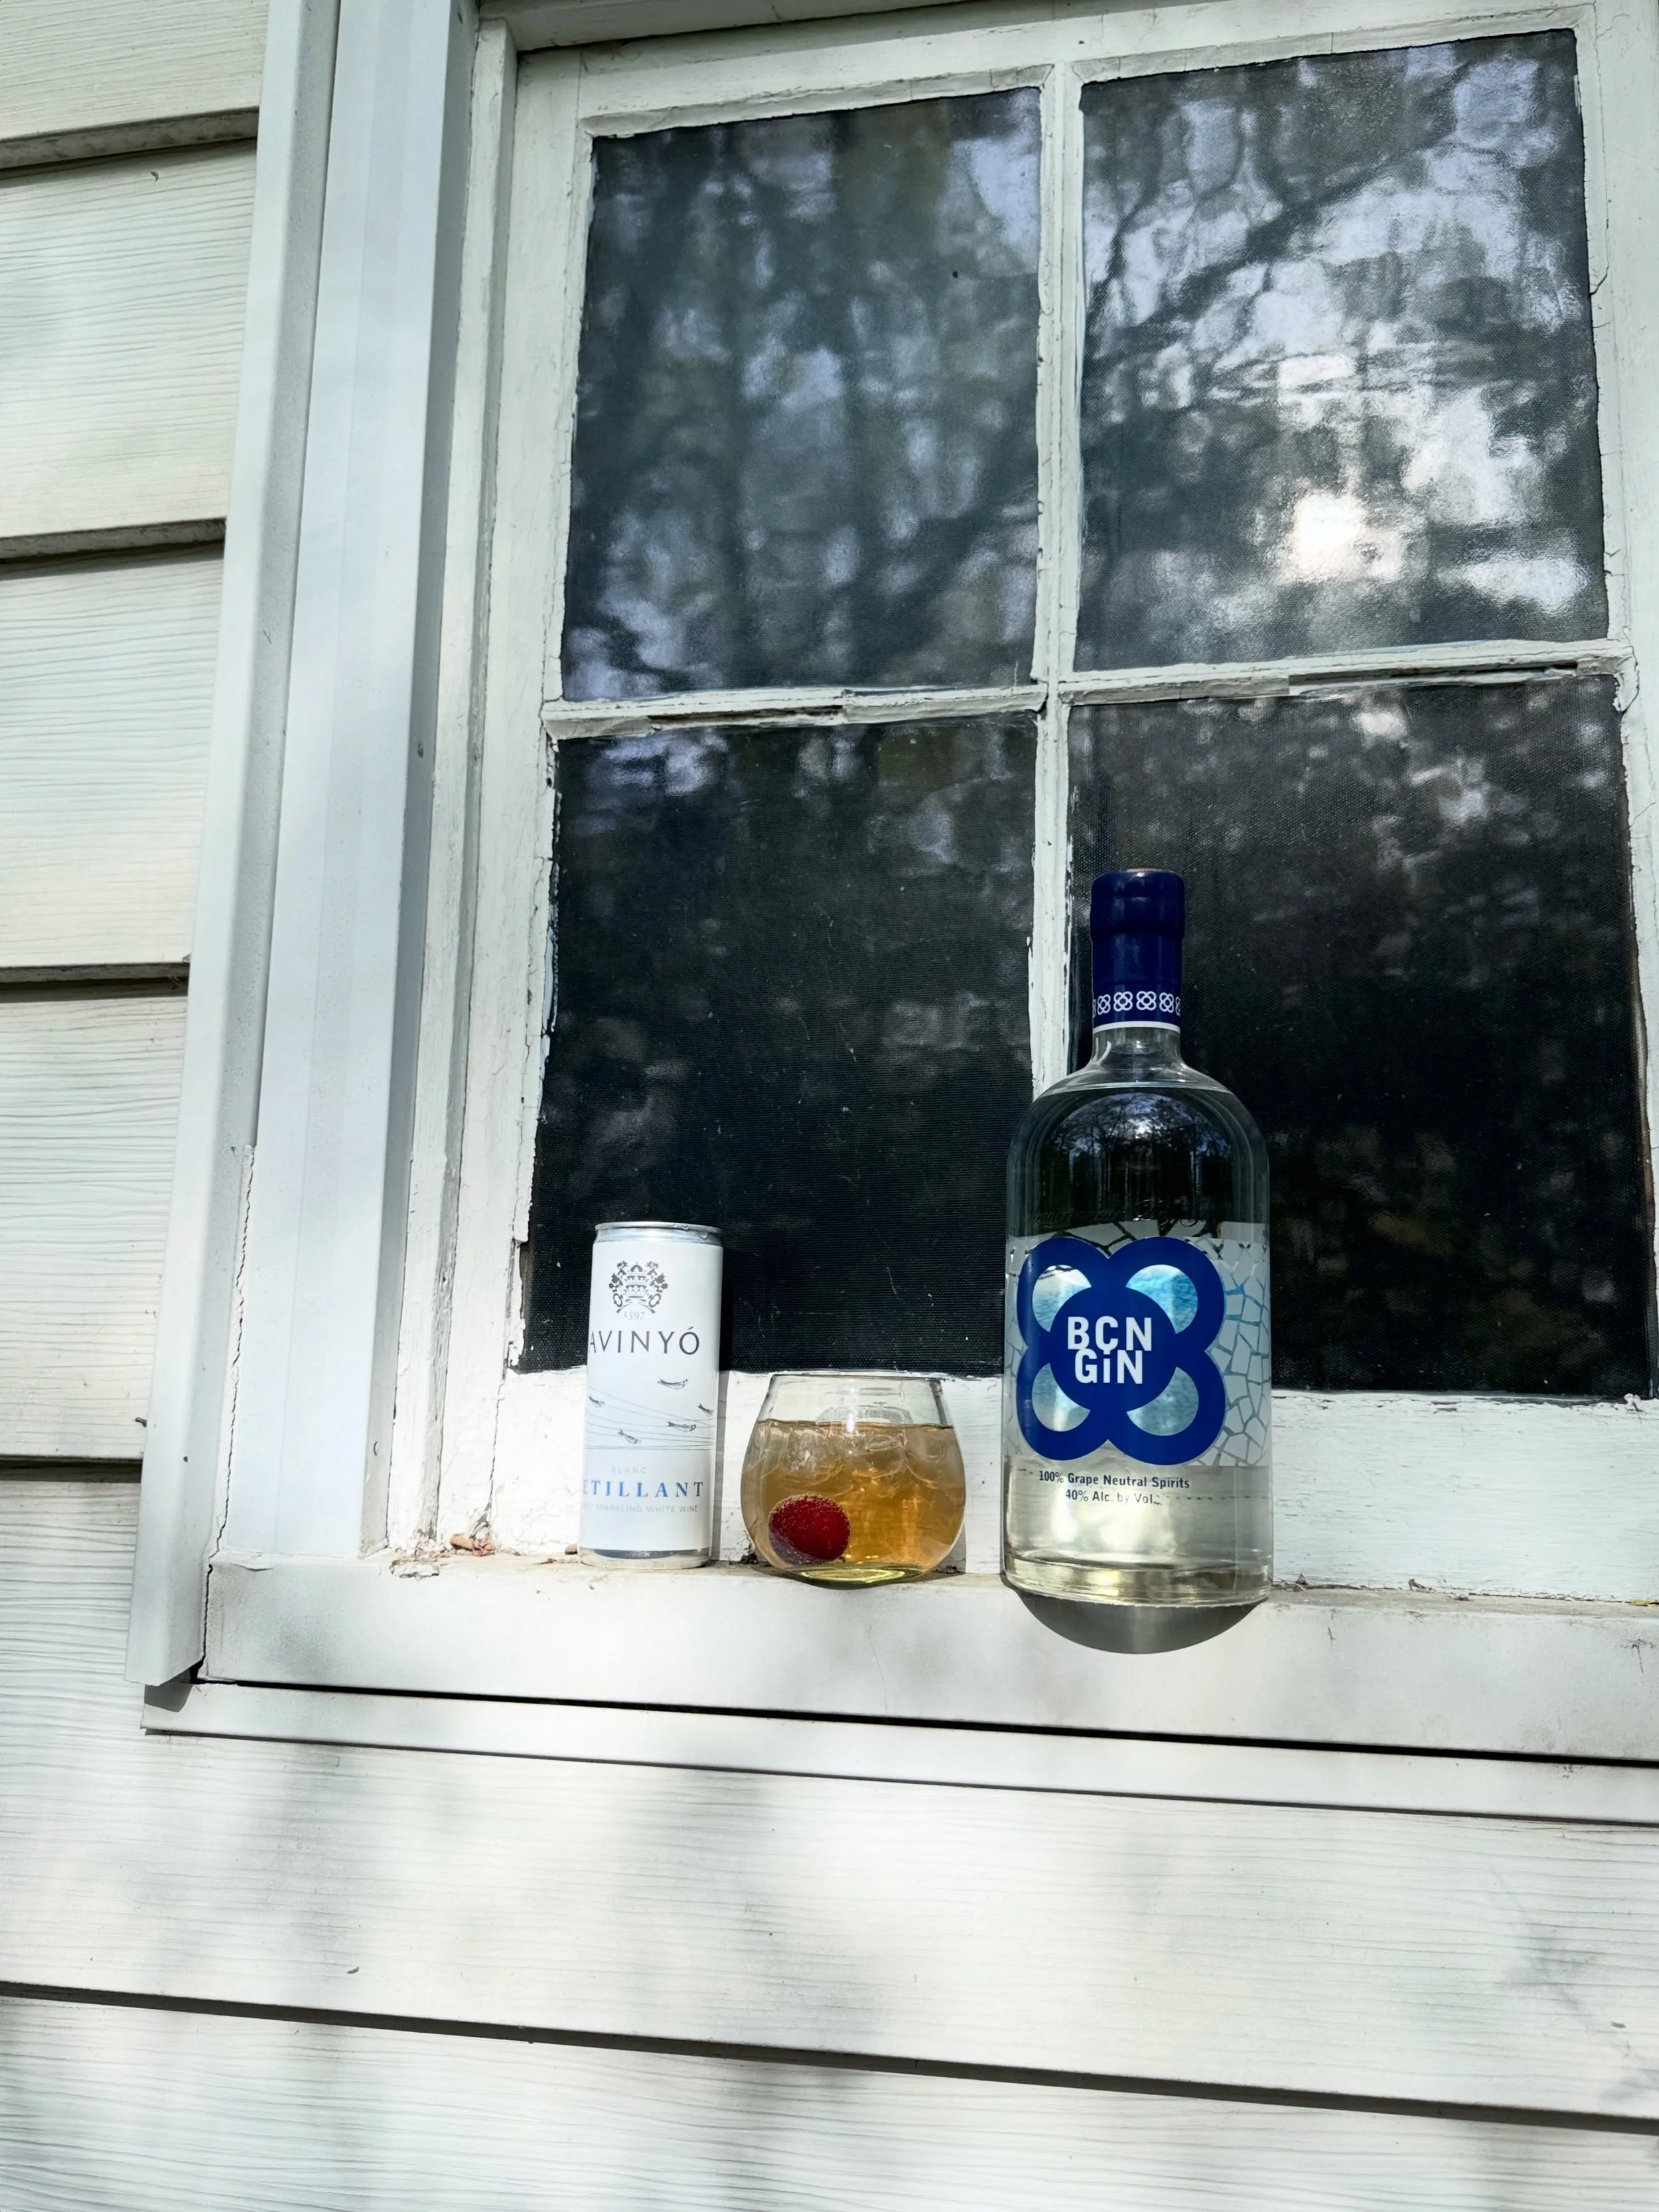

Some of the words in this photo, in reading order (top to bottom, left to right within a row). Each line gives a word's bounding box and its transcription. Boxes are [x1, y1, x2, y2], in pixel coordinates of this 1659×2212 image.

[624, 1311, 645, 1321] 1597
[1039, 1470, 1064, 1483] 100%
[1068, 1472, 1099, 1487] Grape
[1104, 1475, 1147, 1487] Neutral
[1151, 1477, 1190, 1489] Spirits
[1065, 1489, 1088, 1502] 40%
[1092, 1491, 1114, 1502] Alc.
[1117, 1492, 1129, 1503] by
[596, 1503, 642, 1512] SPARKLING
